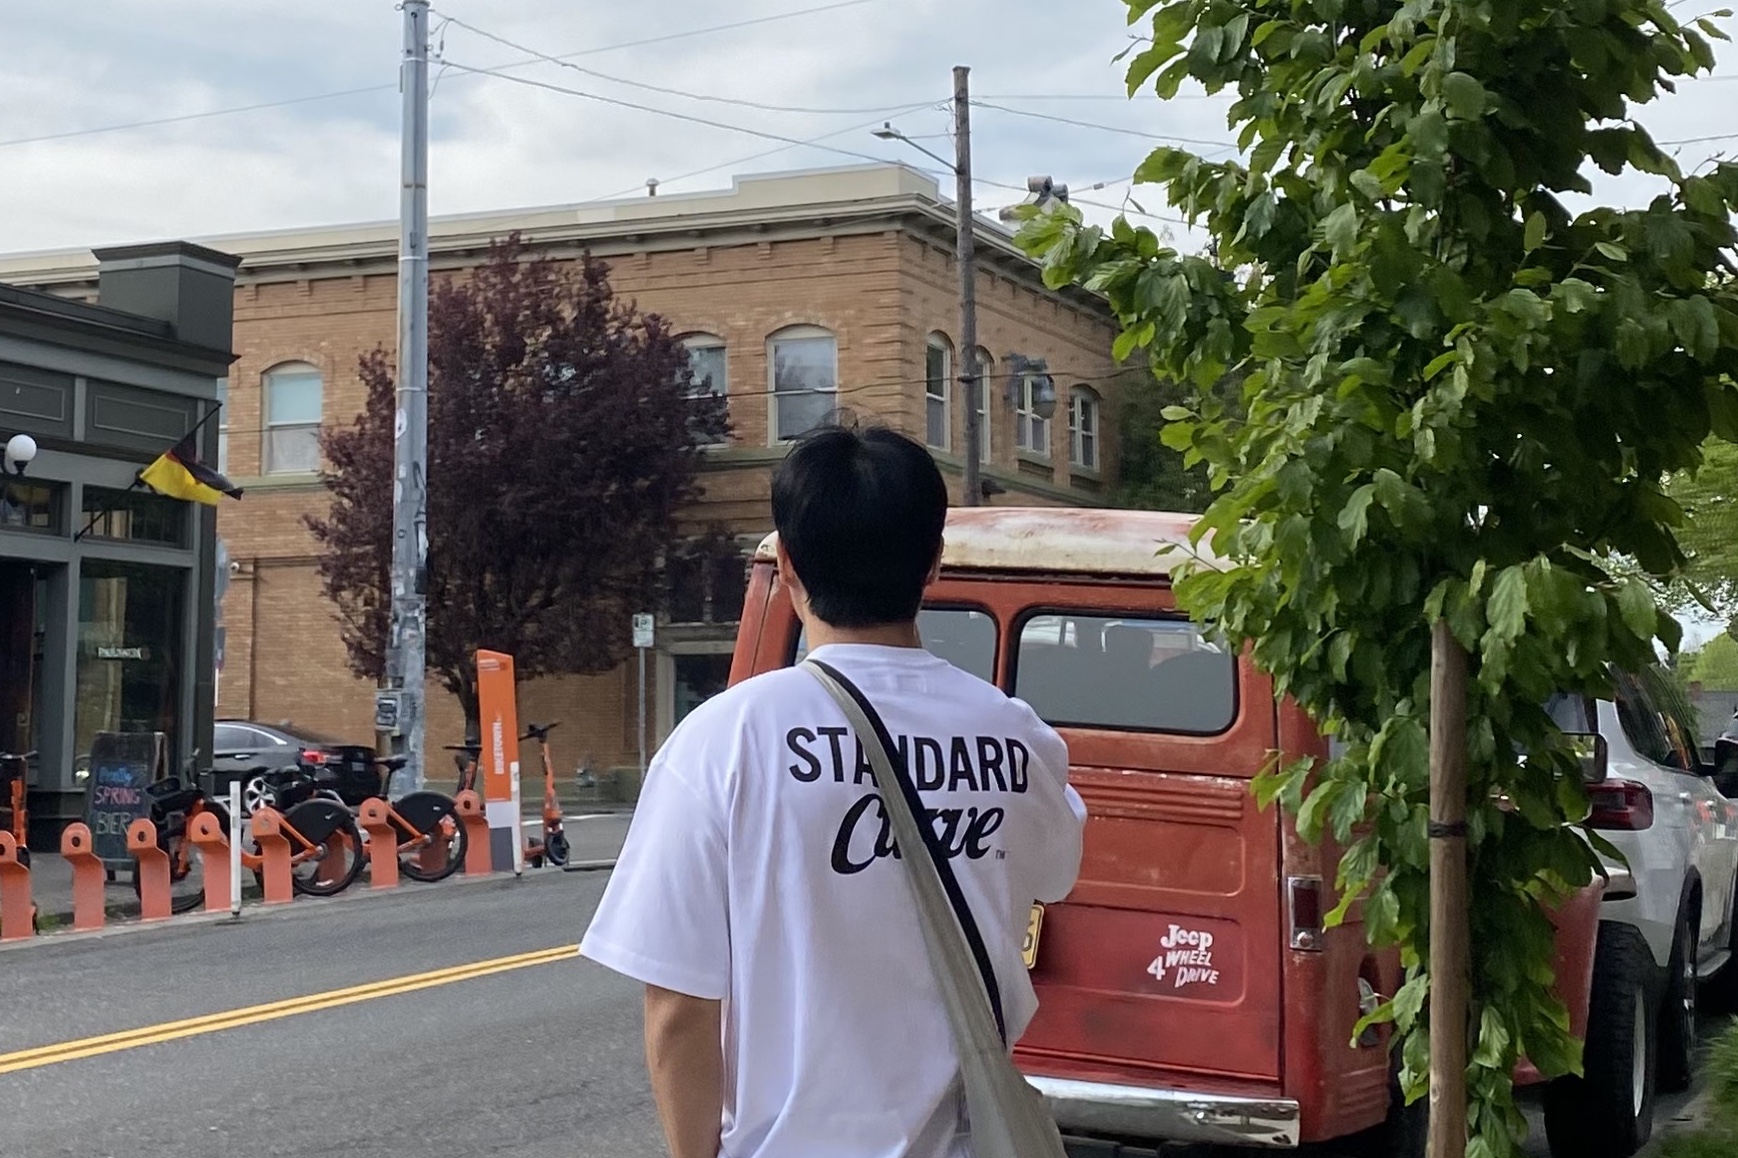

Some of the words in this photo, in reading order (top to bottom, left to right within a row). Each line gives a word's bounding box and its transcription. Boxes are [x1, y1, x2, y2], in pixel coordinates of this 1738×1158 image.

[95, 786, 141, 805] SPRING
[1160, 924, 1214, 951] Jeep
[1146, 955, 1166, 981] 4
[1165, 950, 1212, 968] WHEEL
[1174, 966, 1220, 988] DRIVE
